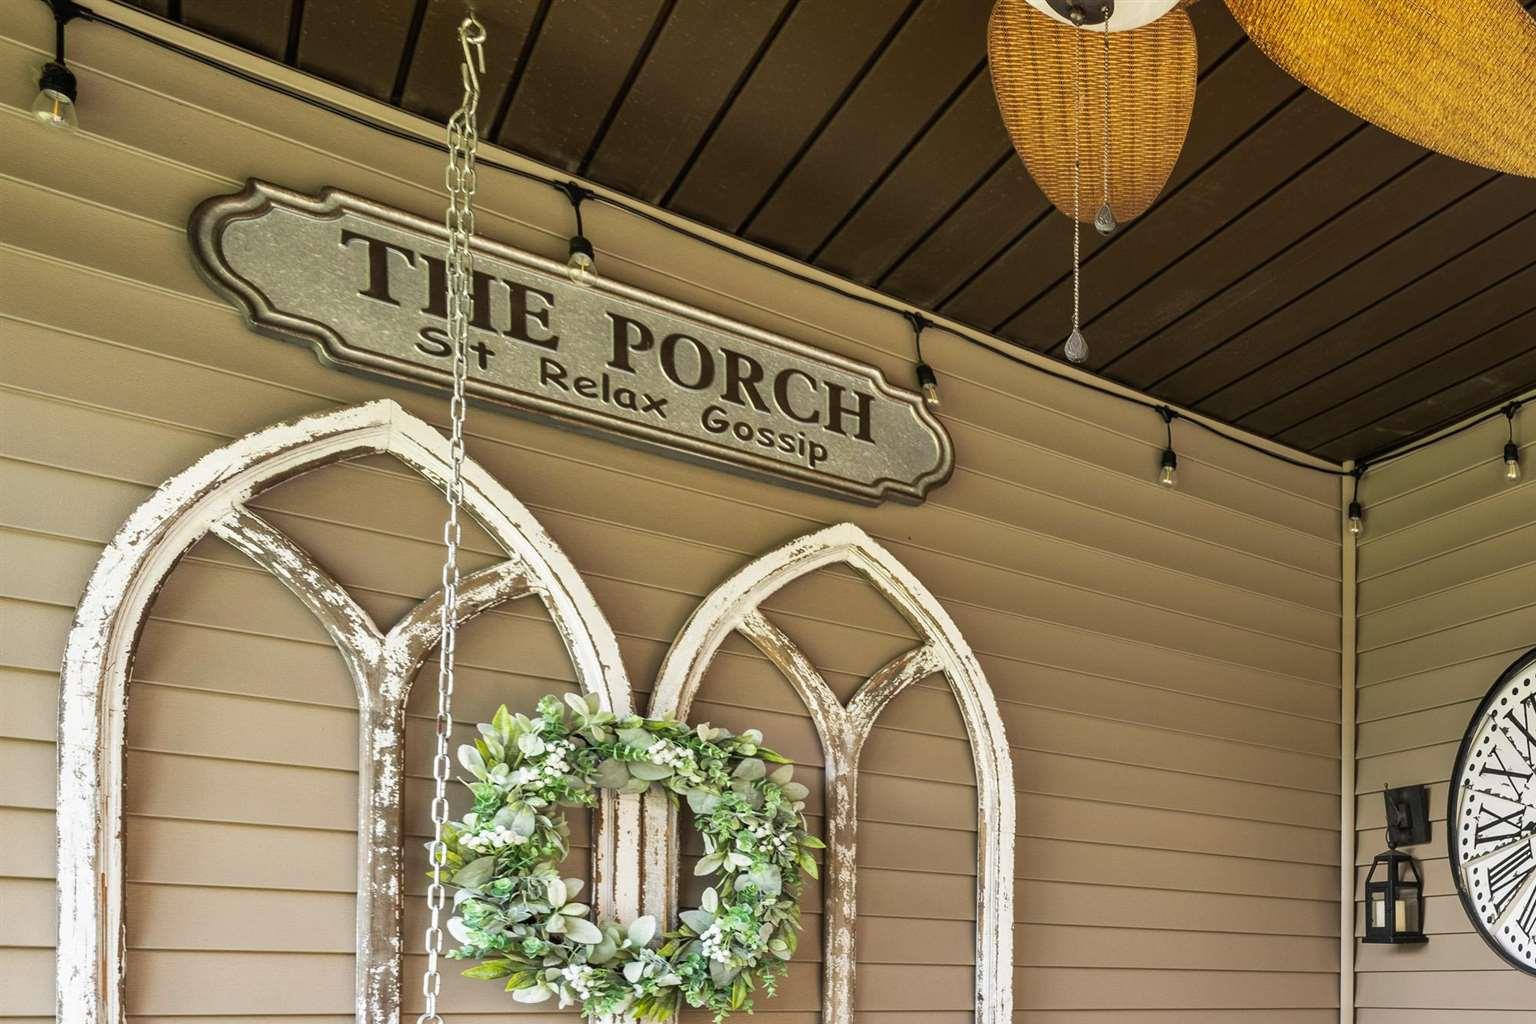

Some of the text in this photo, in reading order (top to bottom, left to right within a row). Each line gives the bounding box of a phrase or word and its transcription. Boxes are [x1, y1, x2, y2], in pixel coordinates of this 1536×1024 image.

[339, 228, 877, 445] THE PORCH
[414, 327, 828, 468] St Relax Gossip
